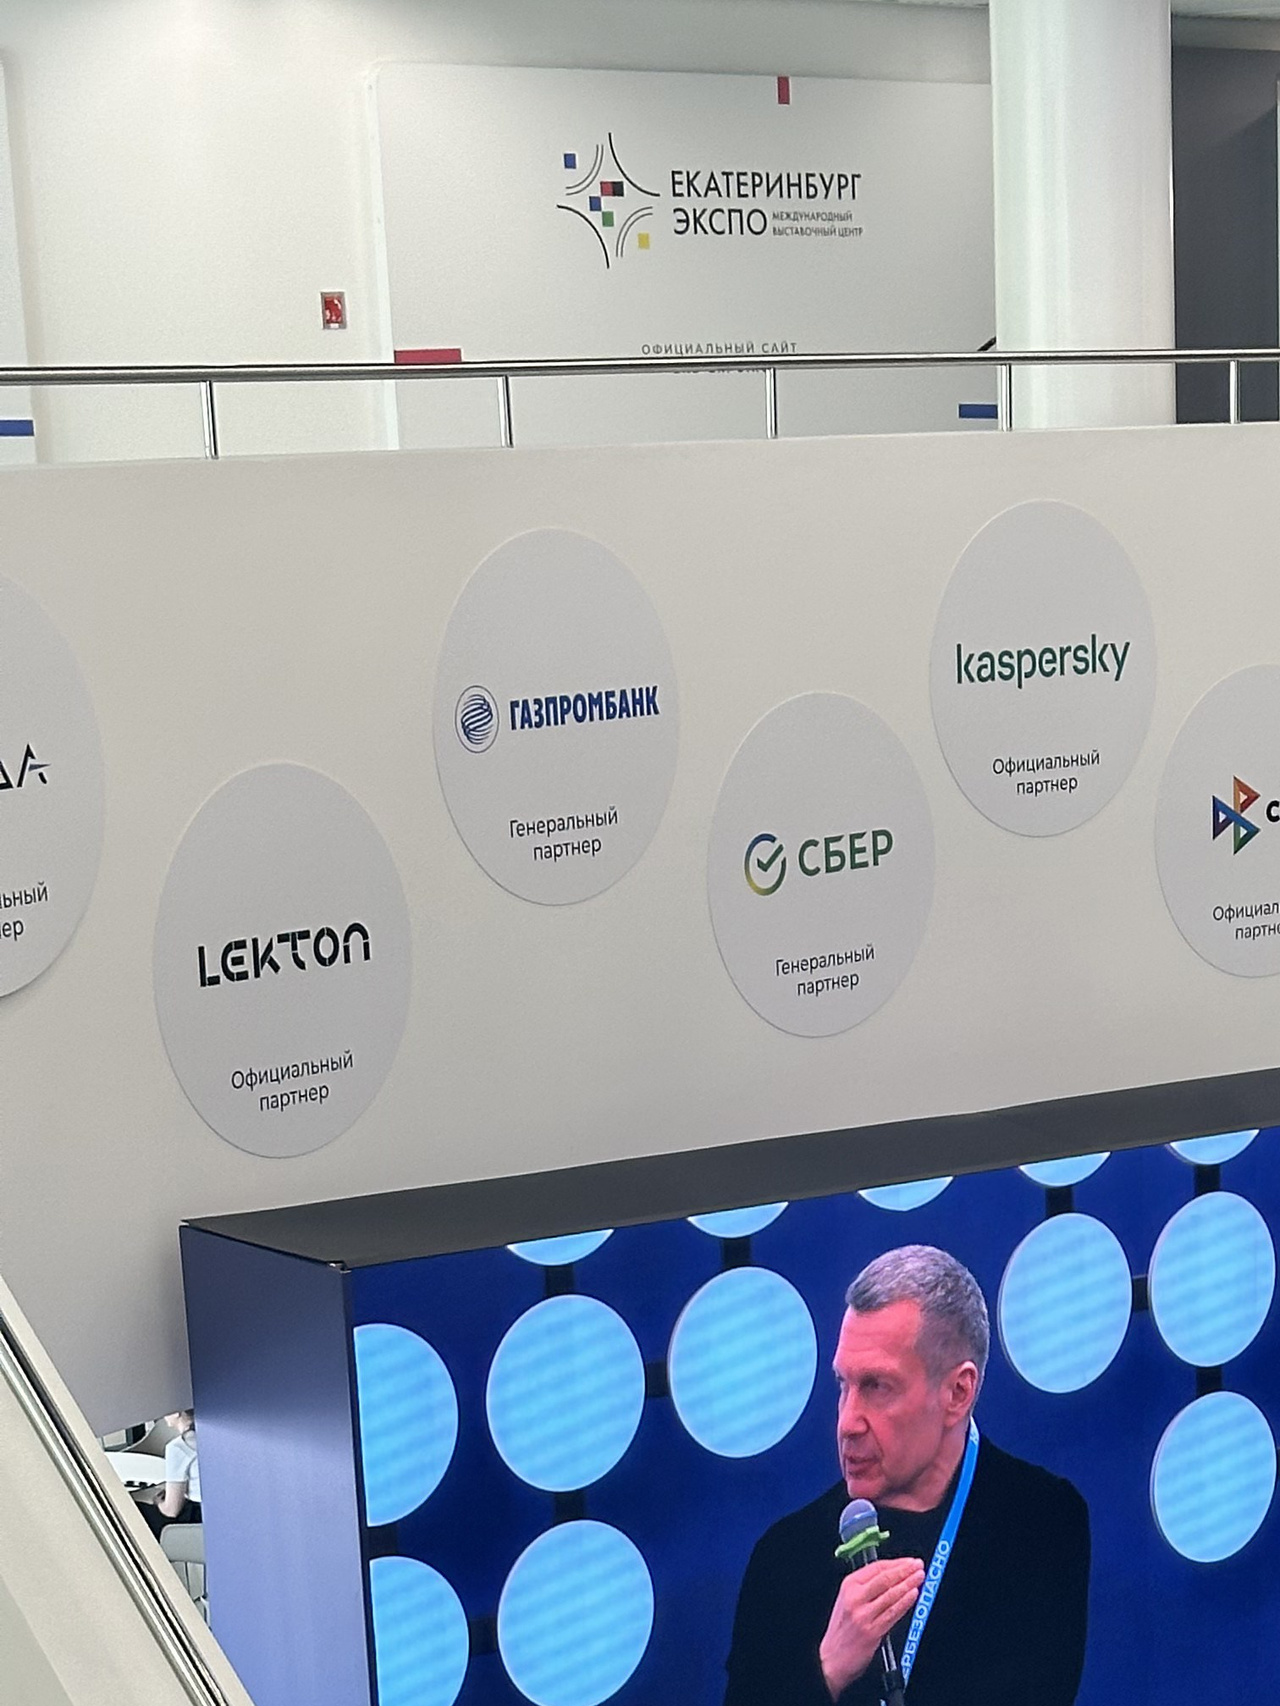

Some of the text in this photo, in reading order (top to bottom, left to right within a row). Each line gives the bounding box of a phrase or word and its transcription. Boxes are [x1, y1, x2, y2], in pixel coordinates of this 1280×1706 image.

[671, 170, 862, 201] ЕКАТЕРИНБУРГ
[672, 207, 768, 236] ЭКСПО
[772, 210, 853, 222] МЕЖДУНАРОДНЫЙ
[772, 226, 863, 238] ВЫСТАВОЧНЫЙ ЦЕНТР
[641, 341, 798, 356] ОФИЦИАЛЬНЫЙ САЙТ
[956, 633, 1131, 690] kaspersky
[509, 685, 660, 731] ГАЗПРОМБАНК
[992, 749, 1100, 776] Официальный
[1016, 777, 1078, 797] партнер
[509, 806, 618, 839] Генеральный
[533, 836, 602, 863] партнер
[798, 829, 893, 877] СБЕР
[775, 944, 875, 977] Генеральный
[796, 970, 860, 997] партнер
[231, 1049, 353, 1092] Официальный
[259, 1081, 329, 1112] партнер
